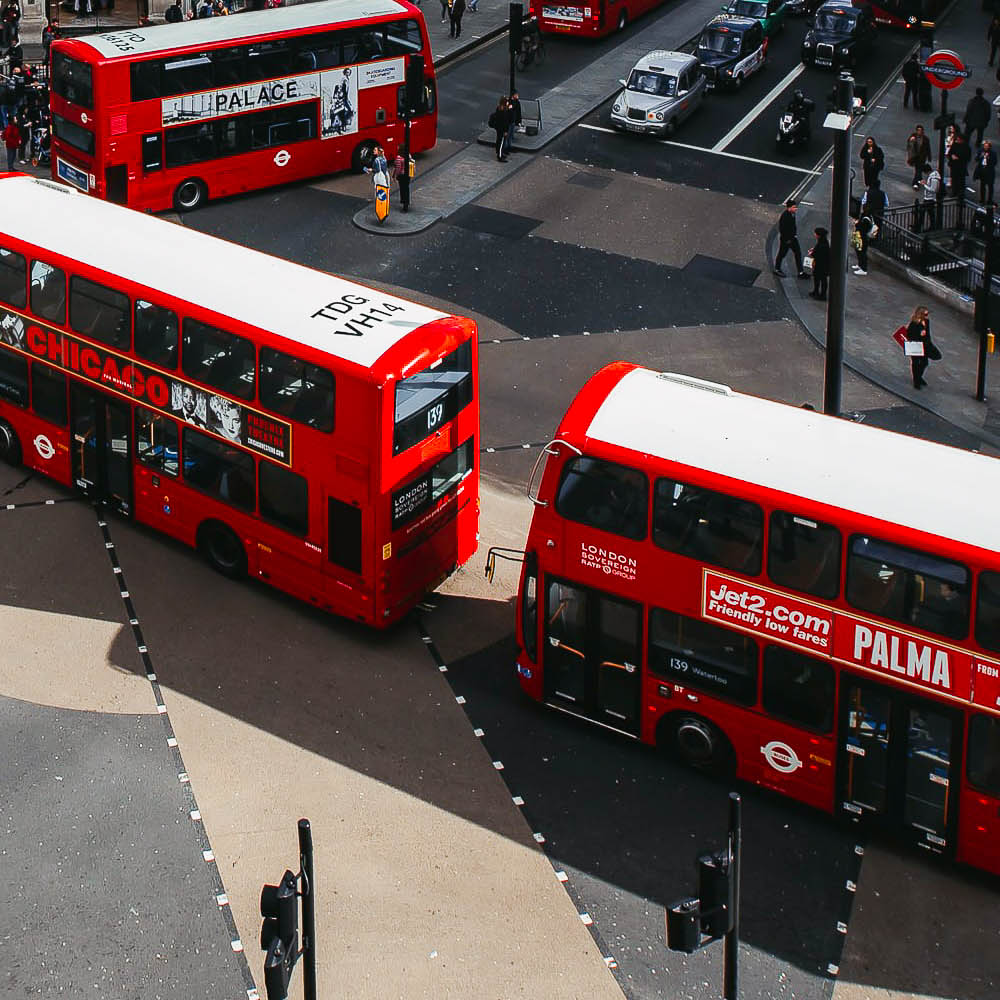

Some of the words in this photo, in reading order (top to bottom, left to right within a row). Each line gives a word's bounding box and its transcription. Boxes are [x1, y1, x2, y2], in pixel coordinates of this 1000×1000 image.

[921, 66, 968, 77] UNDERGROUND
[216, 81, 299, 112] PALACE
[310, 294, 371, 321] TDG
[333, 302, 406, 337] VH14
[26, 325, 169, 407] CHICAGO
[427, 403, 443, 429] 139
[395, 480, 428, 507] LONDON
[581, 542, 637, 568] LONDON
[581, 551, 637, 575] SOVEREIGN
[709, 584, 830, 636] Jet2.com
[708, 600, 763, 627] Friendly
[765, 617, 790, 634] low
[792, 626, 829, 648] fares
[853, 624, 951, 689] PALMA
[670, 657, 689, 672] 139
[691, 665, 728, 685] Waterloo
[977, 663, 999, 678] FROM
